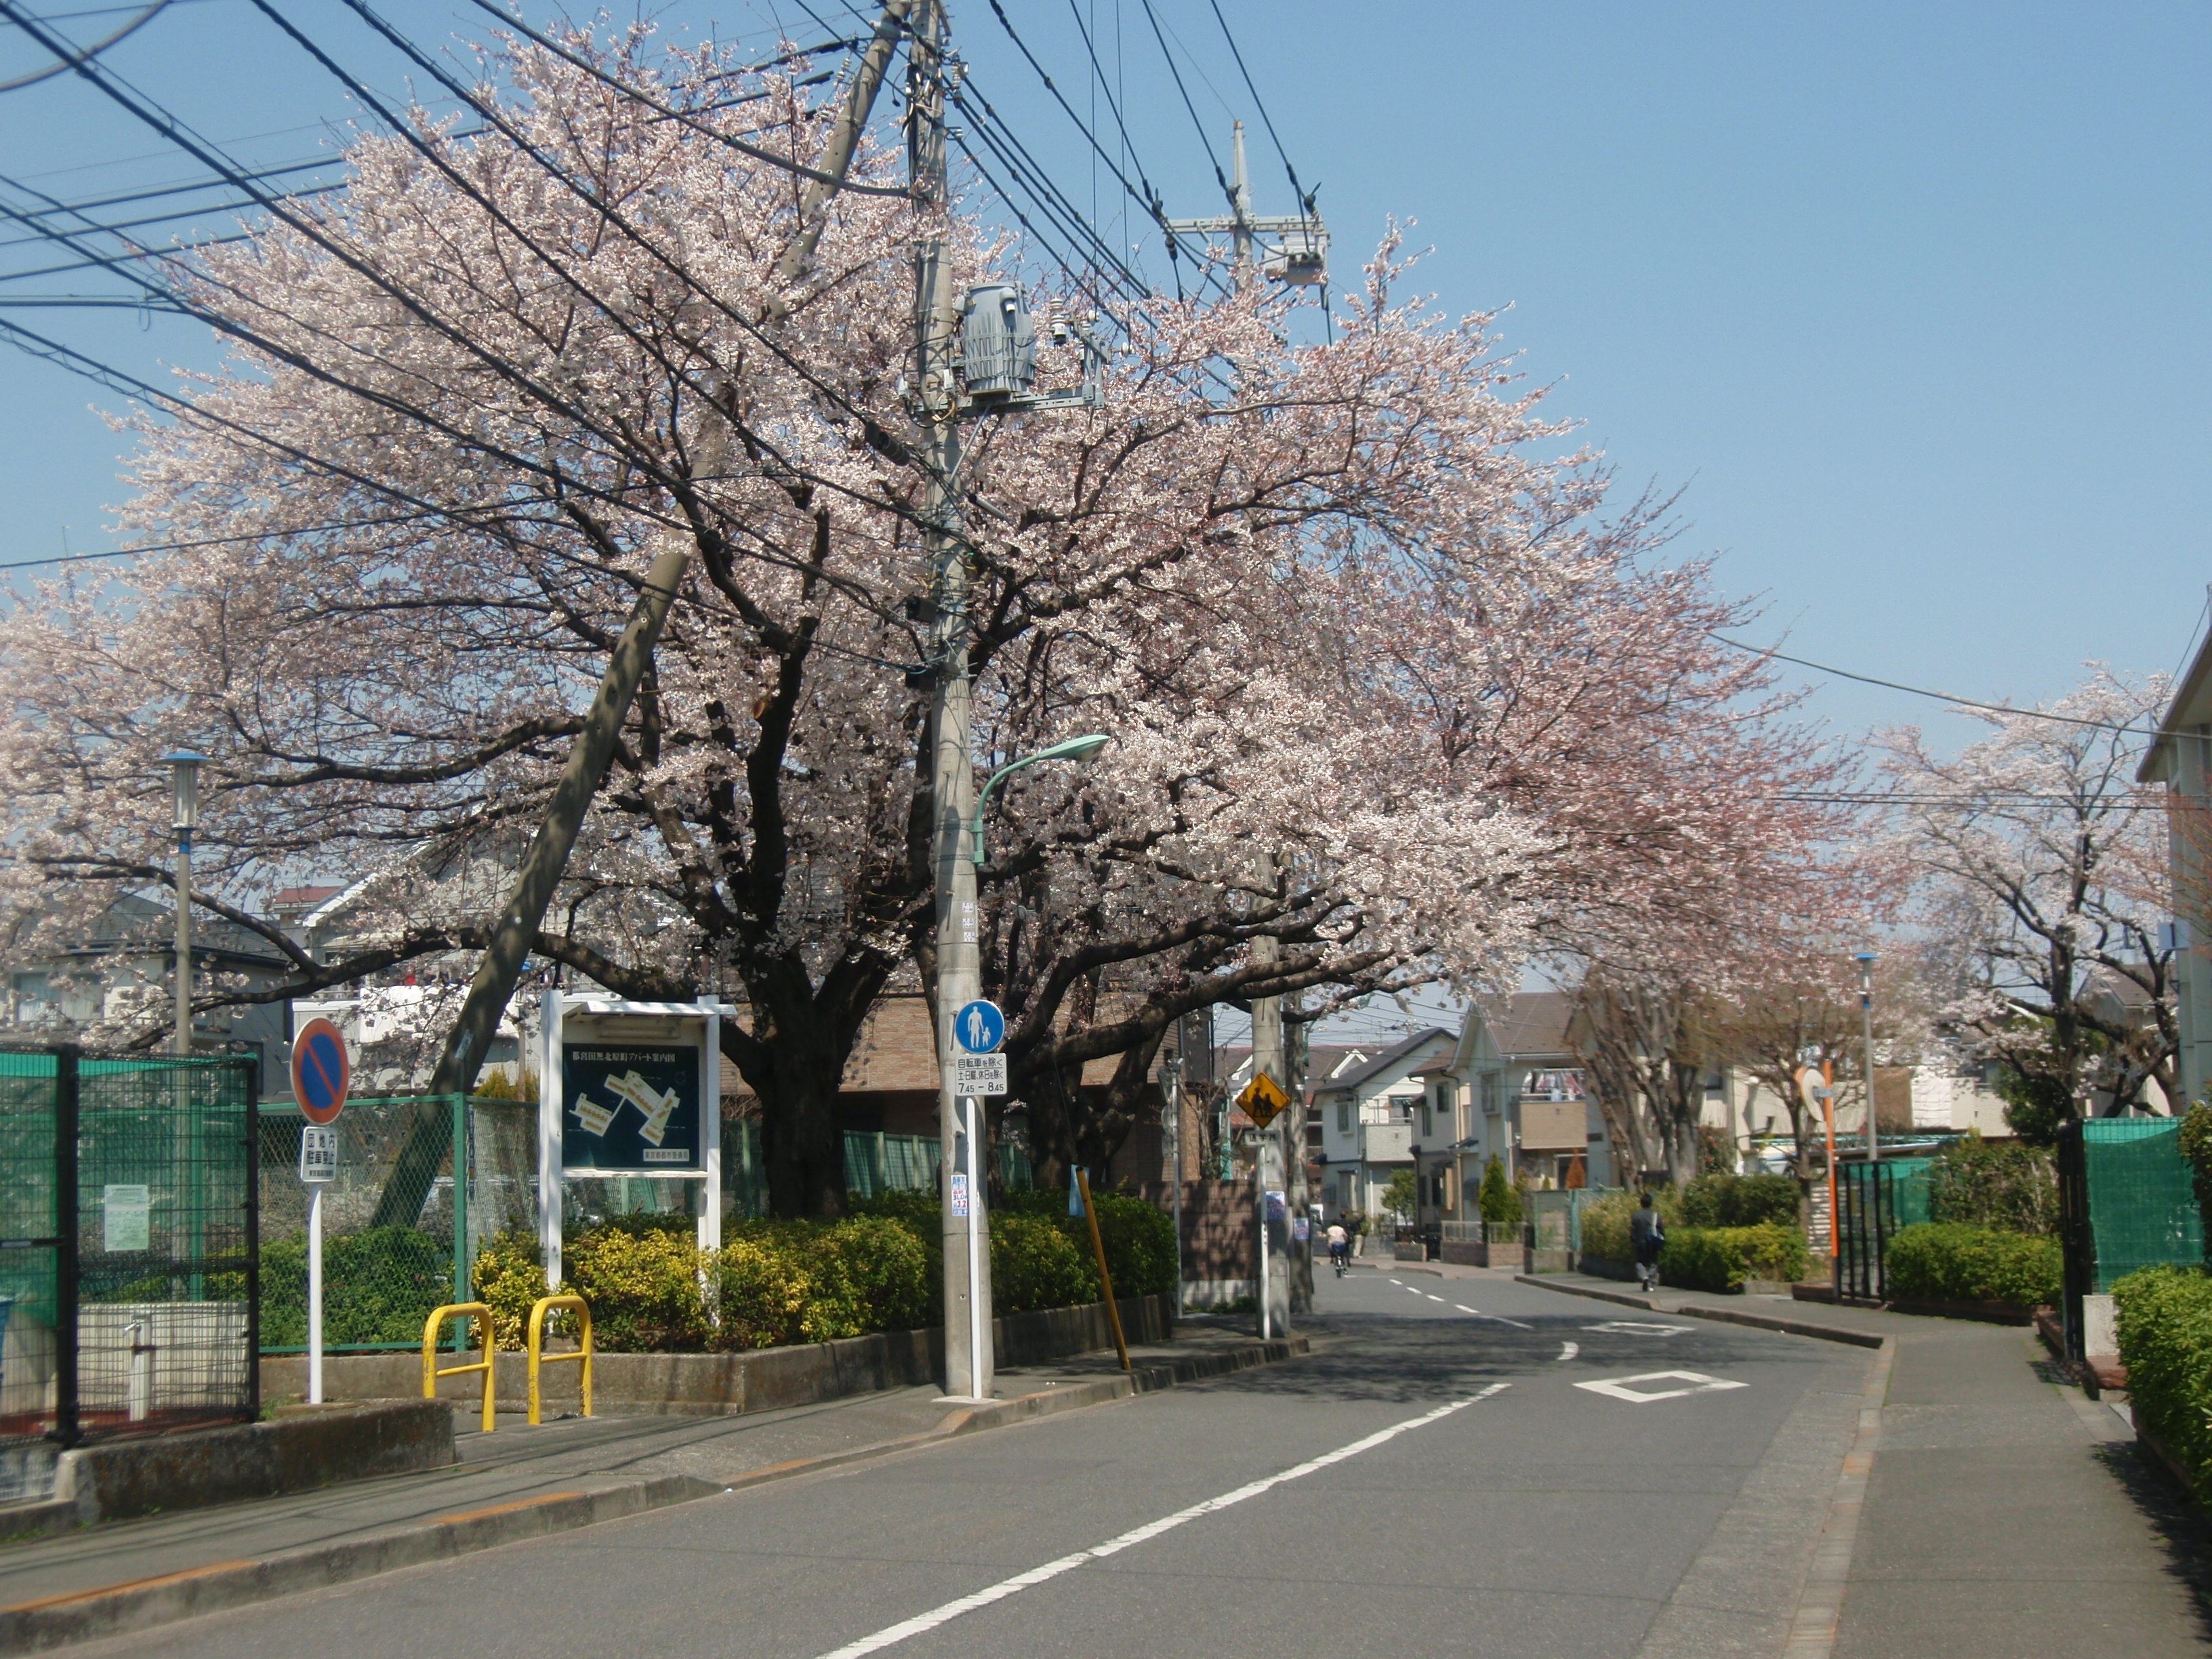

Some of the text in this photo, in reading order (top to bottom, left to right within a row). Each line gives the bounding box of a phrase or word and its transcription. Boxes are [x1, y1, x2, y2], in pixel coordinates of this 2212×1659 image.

[958, 1057, 1002, 1068] 自転車を除く
[307, 1150, 334, 1164] 駐車禁止
